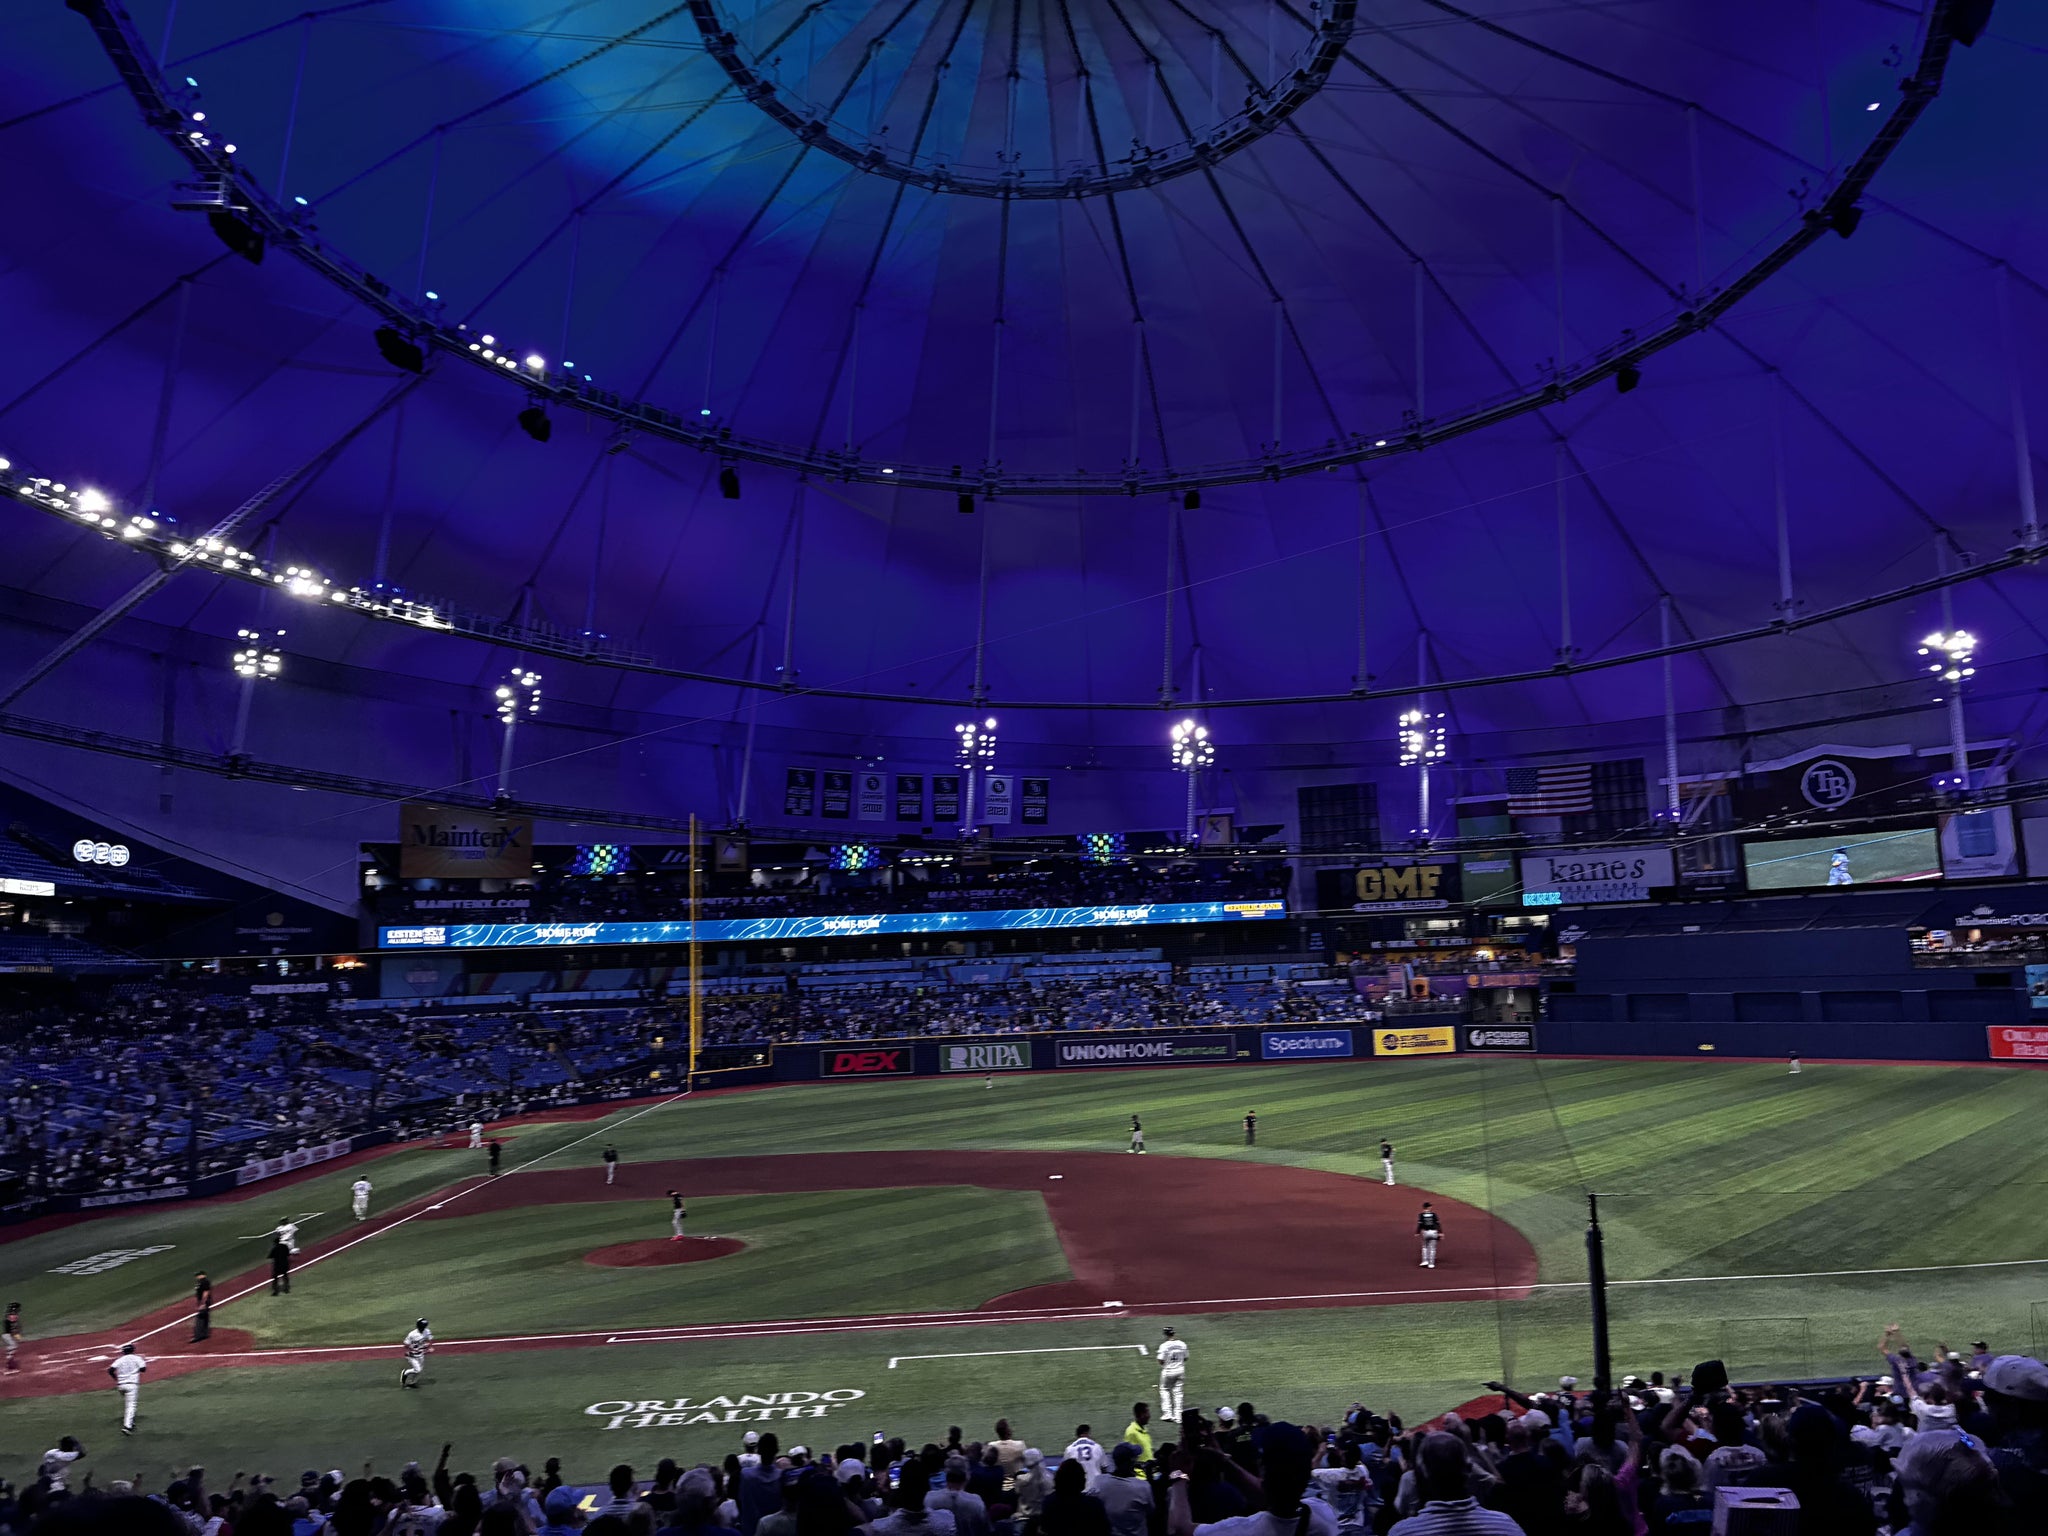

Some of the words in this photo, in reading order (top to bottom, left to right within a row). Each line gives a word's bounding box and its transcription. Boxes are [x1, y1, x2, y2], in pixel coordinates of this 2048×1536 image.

[1810, 769, 1848, 799] TB
[1355, 866, 1442, 900] GMF
[1546, 859, 1645, 883] kanes
[1268, 1034, 1338, 1054] Spectrum
[832, 1050, 902, 1073] DEX
[968, 1045, 1025, 1068] RIPA
[584, 1389, 866, 1415] ORLANDO
[601, 1404, 828, 1430] HEALTH
[1077, 1446, 1092, 1461] 13
